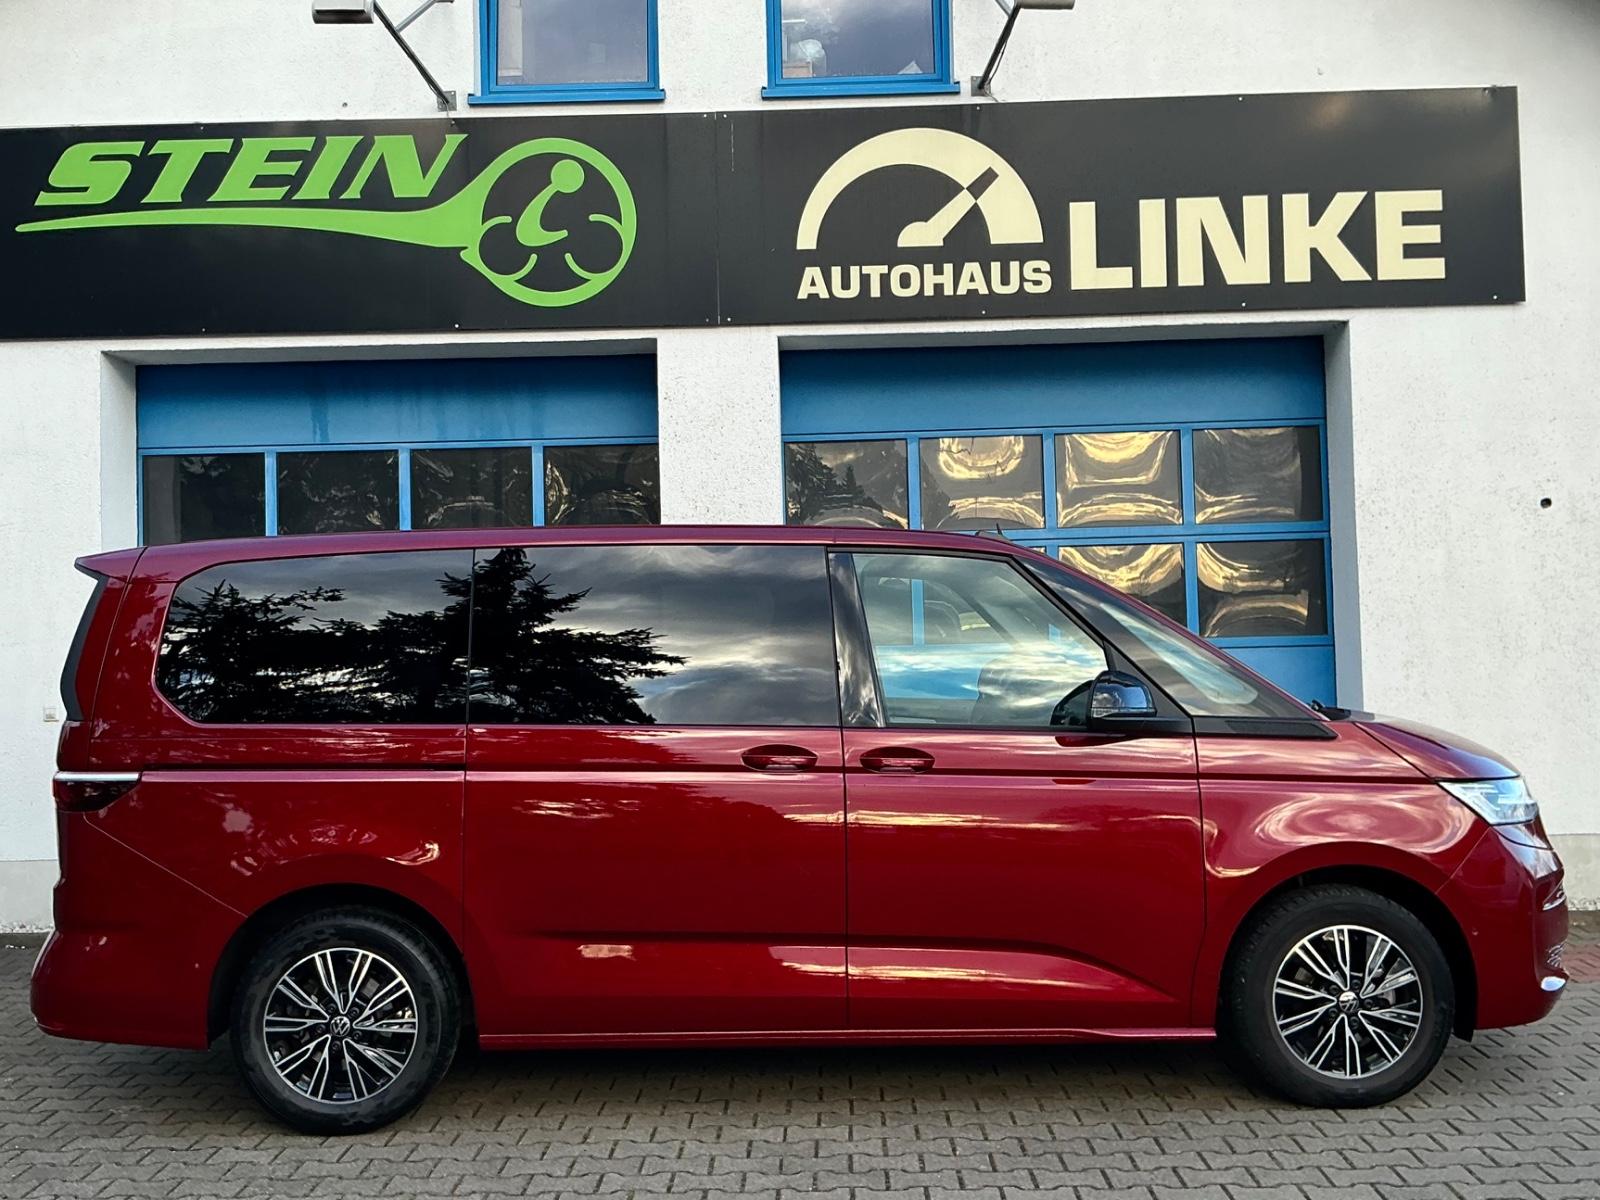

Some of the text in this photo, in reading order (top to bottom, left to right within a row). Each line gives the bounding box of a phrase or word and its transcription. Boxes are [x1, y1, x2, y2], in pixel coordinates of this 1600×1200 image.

[35, 134, 468, 206] STEIN
[797, 189, 1446, 300] AUTOHAUS LINKE
